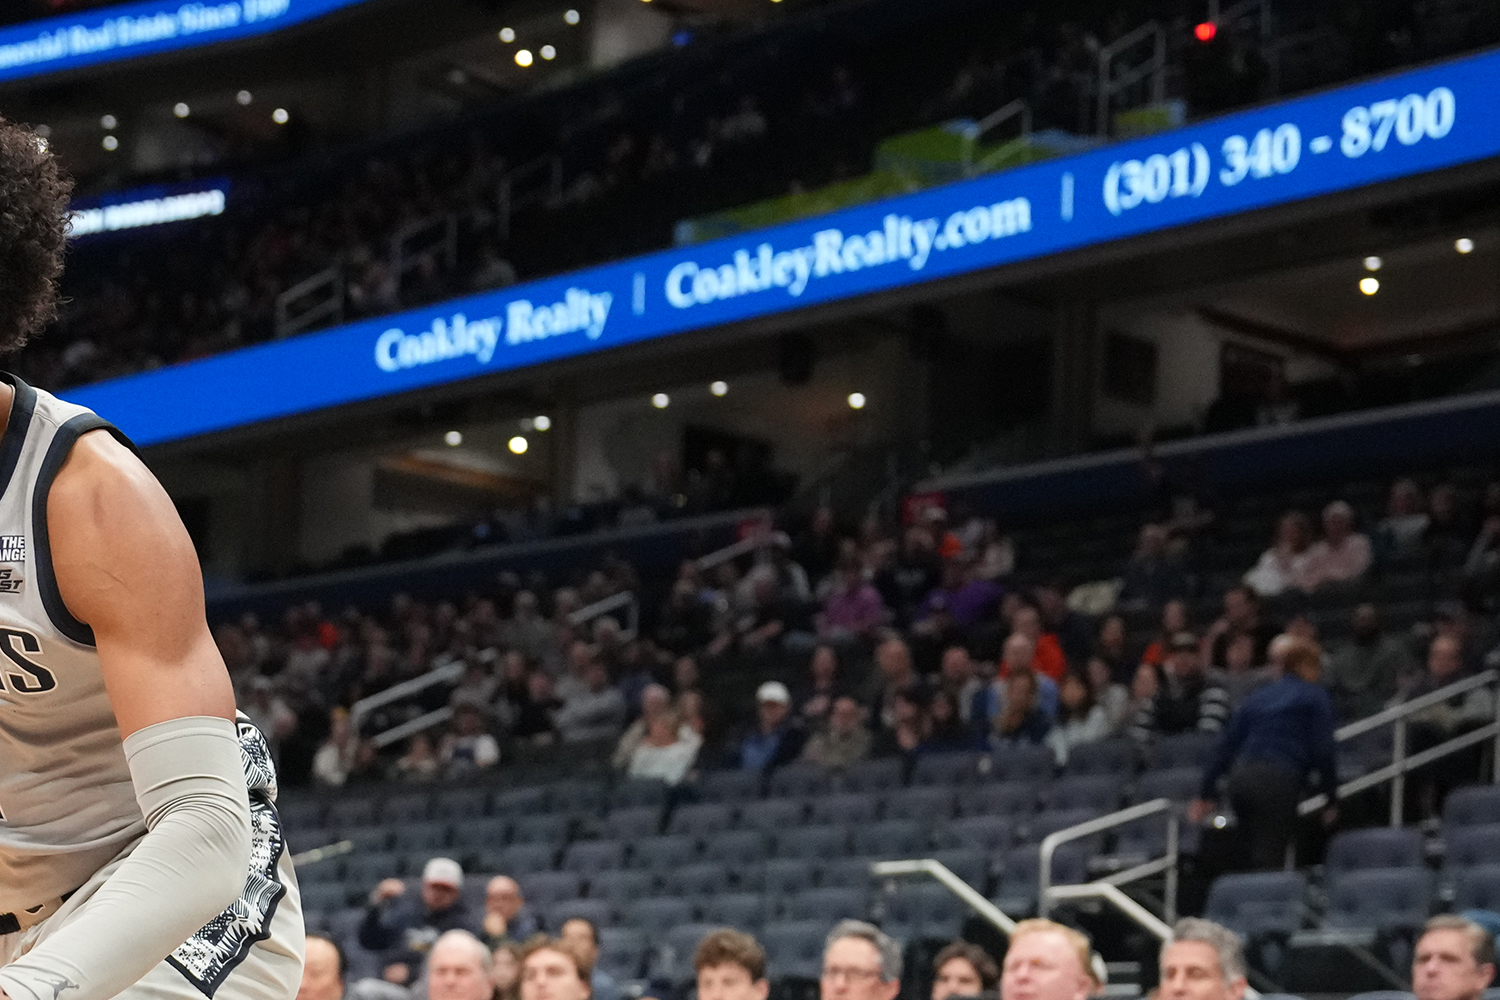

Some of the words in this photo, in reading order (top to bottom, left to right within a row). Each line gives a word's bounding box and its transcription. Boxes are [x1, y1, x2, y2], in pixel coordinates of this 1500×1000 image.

[374, 311, 501, 371] Coakley
[505, 287, 613, 340] Realty
[664, 197, 1032, 311] CoakleyRealty.com
[1102, 142, 1211, 216] (301)
[1218, 123, 1302, 187] 340
[1339, 86, 1457, 159] 8700
[1, 535, 25, 549] THE
